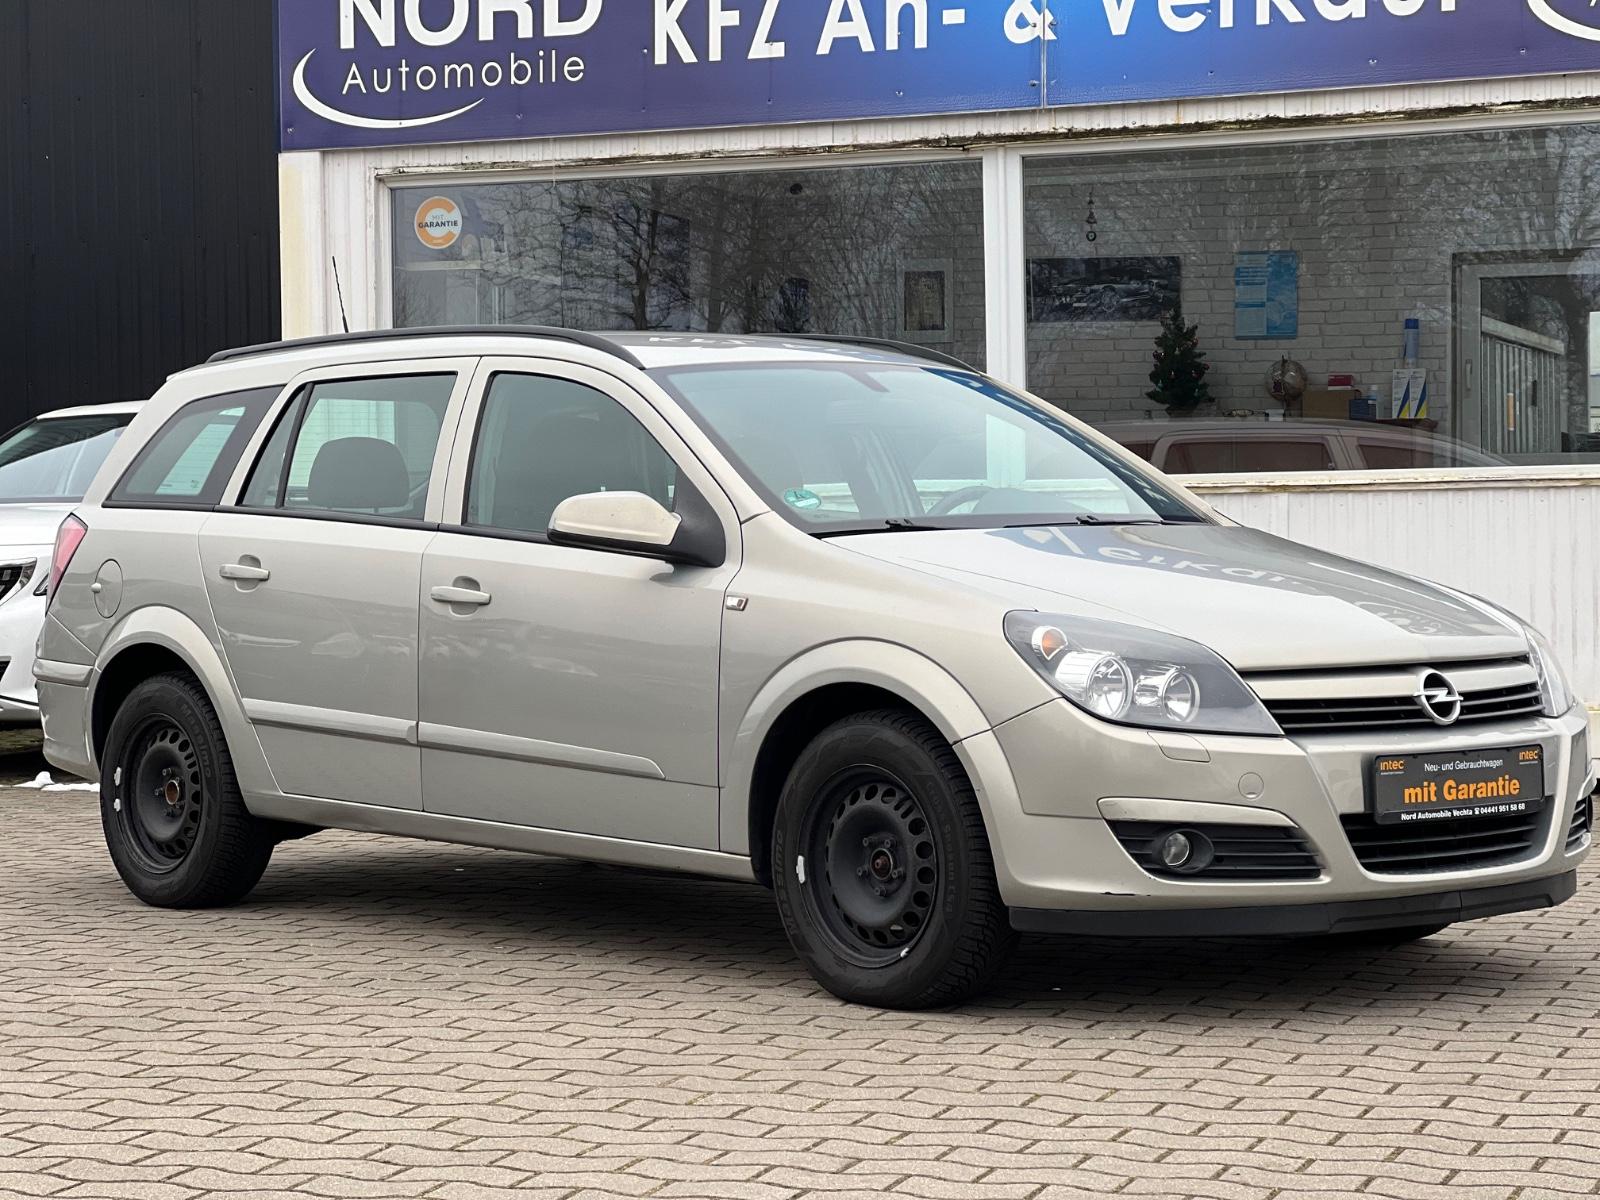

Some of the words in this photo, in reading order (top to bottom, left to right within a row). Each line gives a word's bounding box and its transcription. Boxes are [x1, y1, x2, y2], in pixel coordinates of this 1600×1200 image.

[654, 0, 785, 65] KFZ
[815, 0, 966, 55] An-
[342, 50, 585, 94] Automobile
[418, 220, 458, 228] GARANTIE
[1424, 763, 1441, 772] Neu-
[1441, 761, 1454, 771] und
[1454, 758, 1504, 770] Gebrauchtwagen
[1404, 781, 1437, 804] mit
[1443, 774, 1520, 801] Garantie
[1401, 812, 1417, 821] Nord
[1417, 810, 1452, 819] Automobile
[1452, 808, 1473, 817] Vechta
[1480, 805, 1498, 814] 04441
